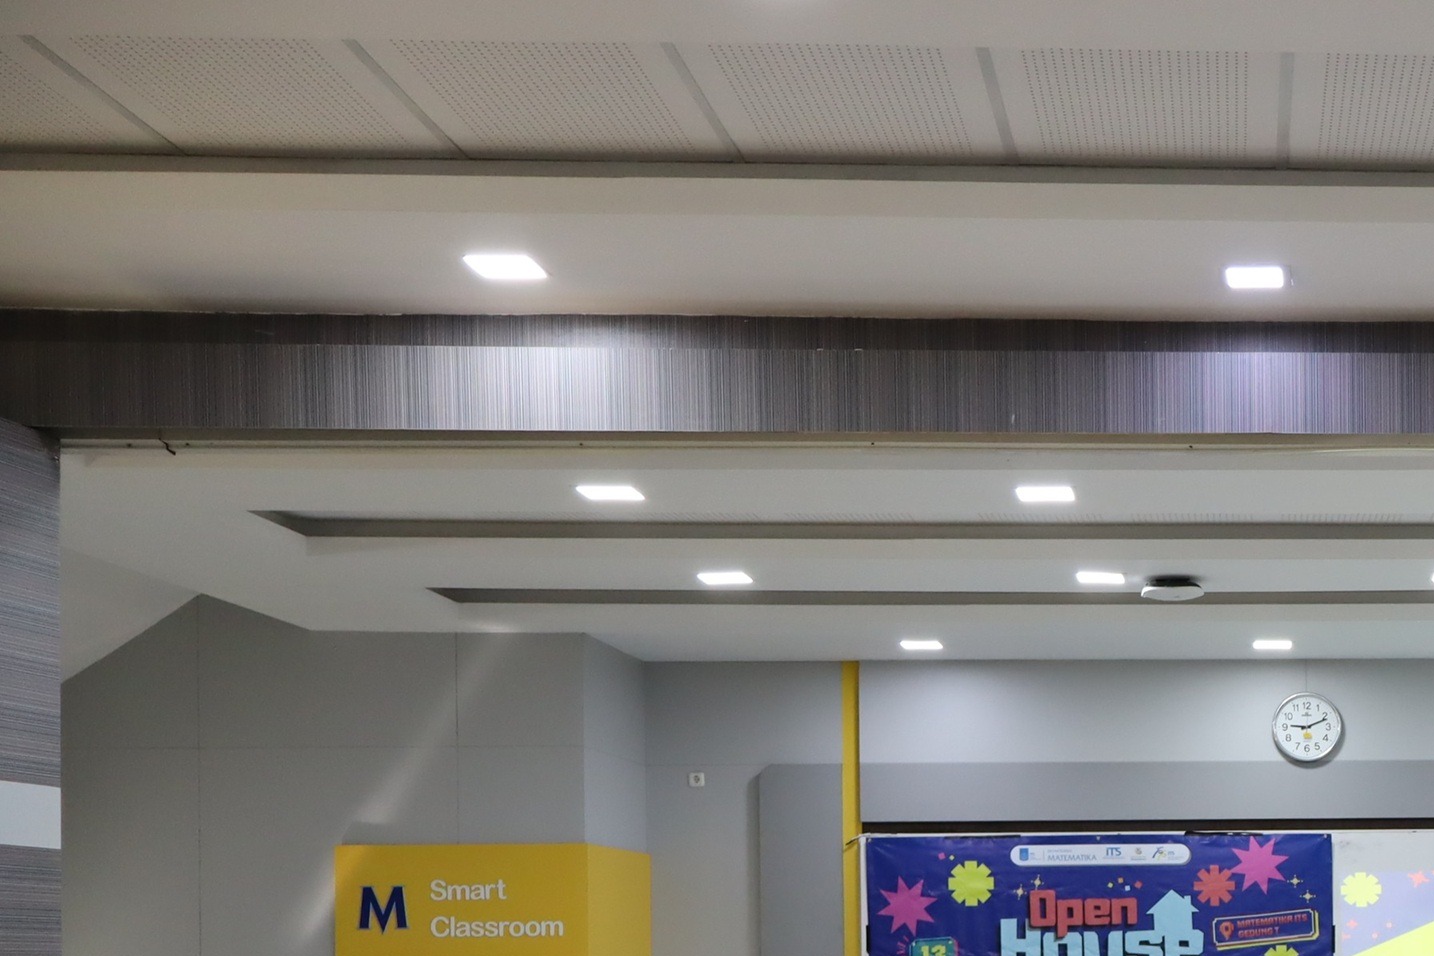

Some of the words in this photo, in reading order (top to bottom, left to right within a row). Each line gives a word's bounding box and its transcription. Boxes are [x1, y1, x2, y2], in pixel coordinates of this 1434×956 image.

[1302, 702, 1311, 710] 12
[1316, 704, 1320, 712] 1
[1284, 712, 1293, 720] 10
[1322, 712, 1328, 720] 2
[1282, 723, 1288, 731] 9
[1325, 723, 1331, 731] 3
[1285, 734, 1292, 742] 8
[1322, 734, 1329, 742] 4
[1295, 742, 1301, 750] 7
[1303, 744, 1310, 752] 6
[1314, 742, 1321, 750] 5
[1106, 847, 1122, 856] ITS
[430, 879, 507, 901] Smart
[357, 886, 409, 935] M
[1029, 890, 1138, 938] Open
[1237, 914, 1293, 928] MATEMATIKA
[1295, 914, 1307, 922] ITS
[430, 916, 564, 938] Classroom
[1238, 927, 1273, 938] GEDUNG
